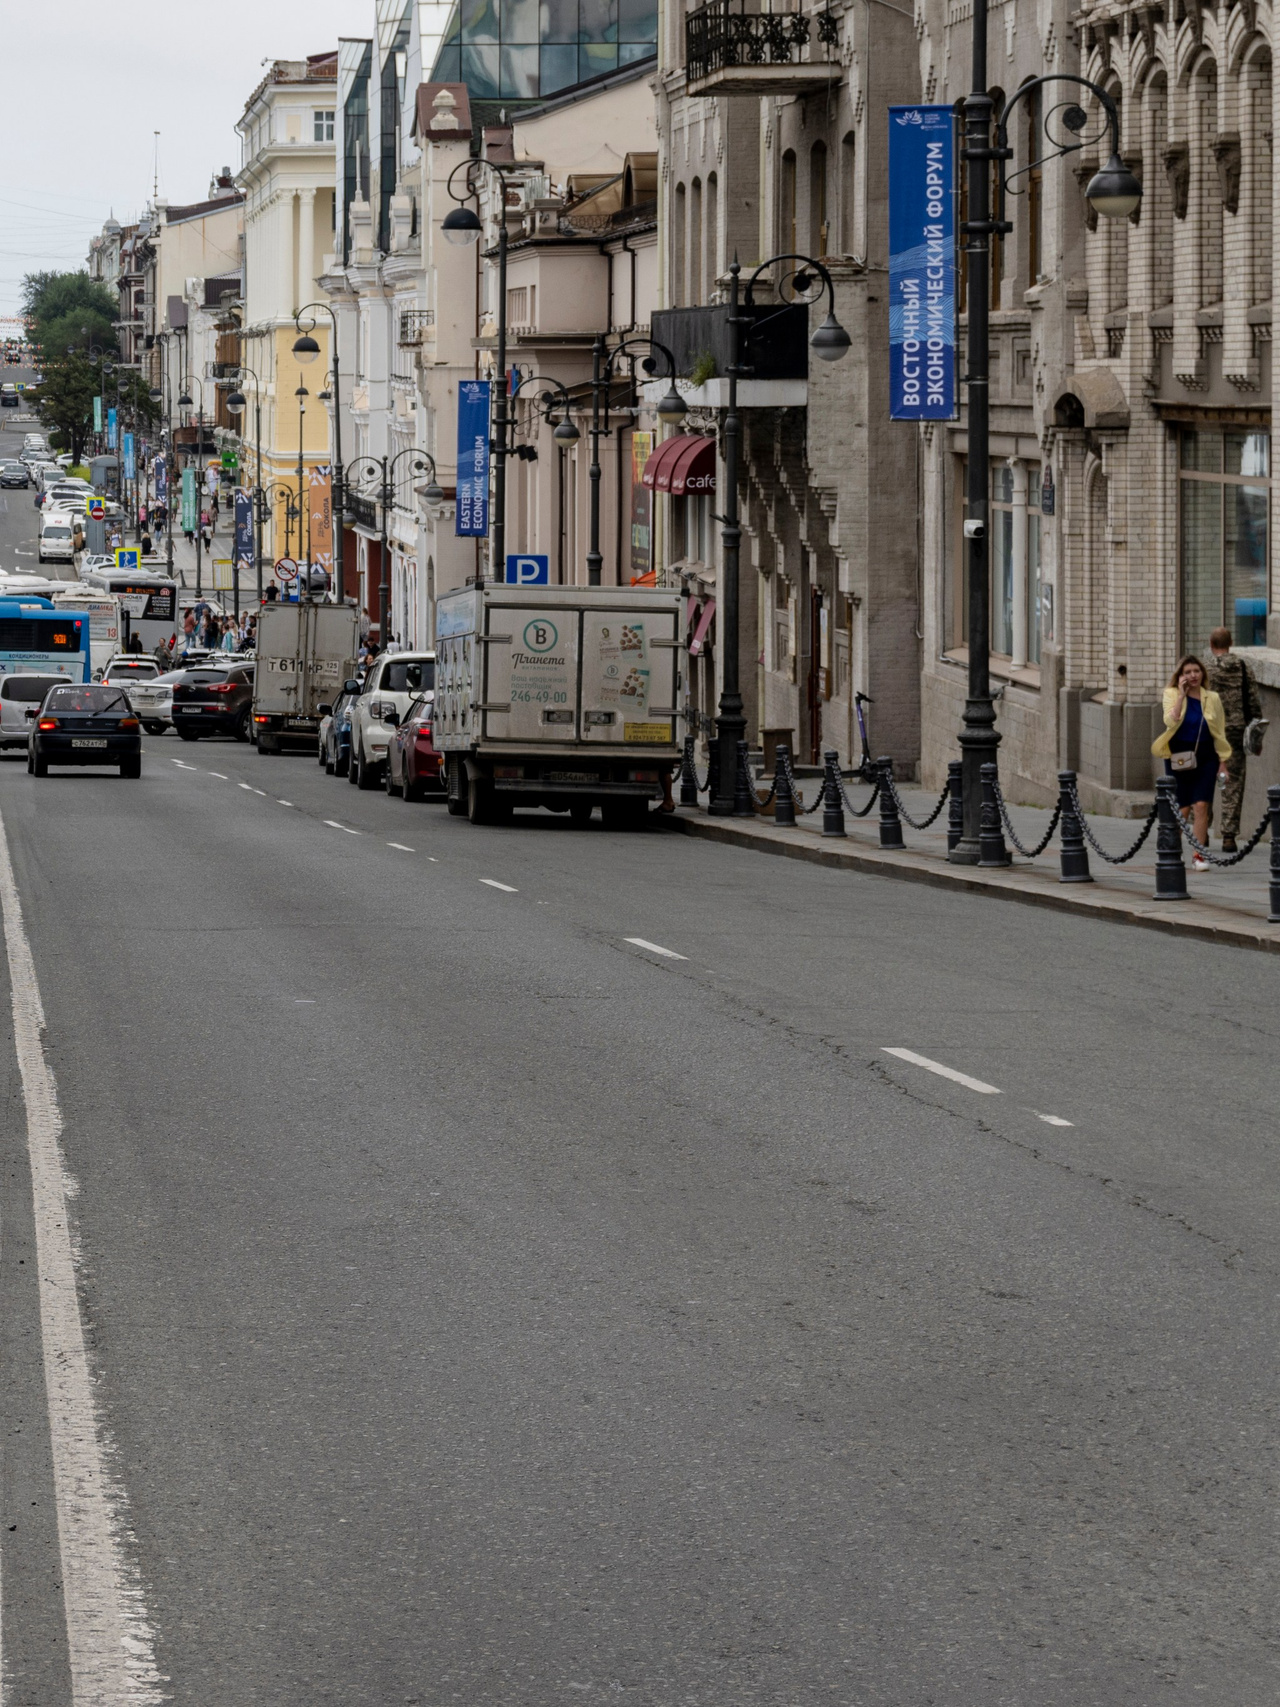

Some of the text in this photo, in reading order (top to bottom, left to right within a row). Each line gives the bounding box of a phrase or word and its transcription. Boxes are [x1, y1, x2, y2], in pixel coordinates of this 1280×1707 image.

[926, 142, 944, 218] ФОРУМ
[900, 278, 920, 406] ВОСТОЧНЫЙ
[924, 224, 944, 406] ЭКОНОМИЧЕСКИЙ
[460, 484, 470, 530] EASTERN
[474, 436, 484, 530] ECONOMIC FORUM
[107, 628, 117, 638] 13
[512, 653, 565, 669] Планета
[511, 690, 567, 703] 246-49-00
